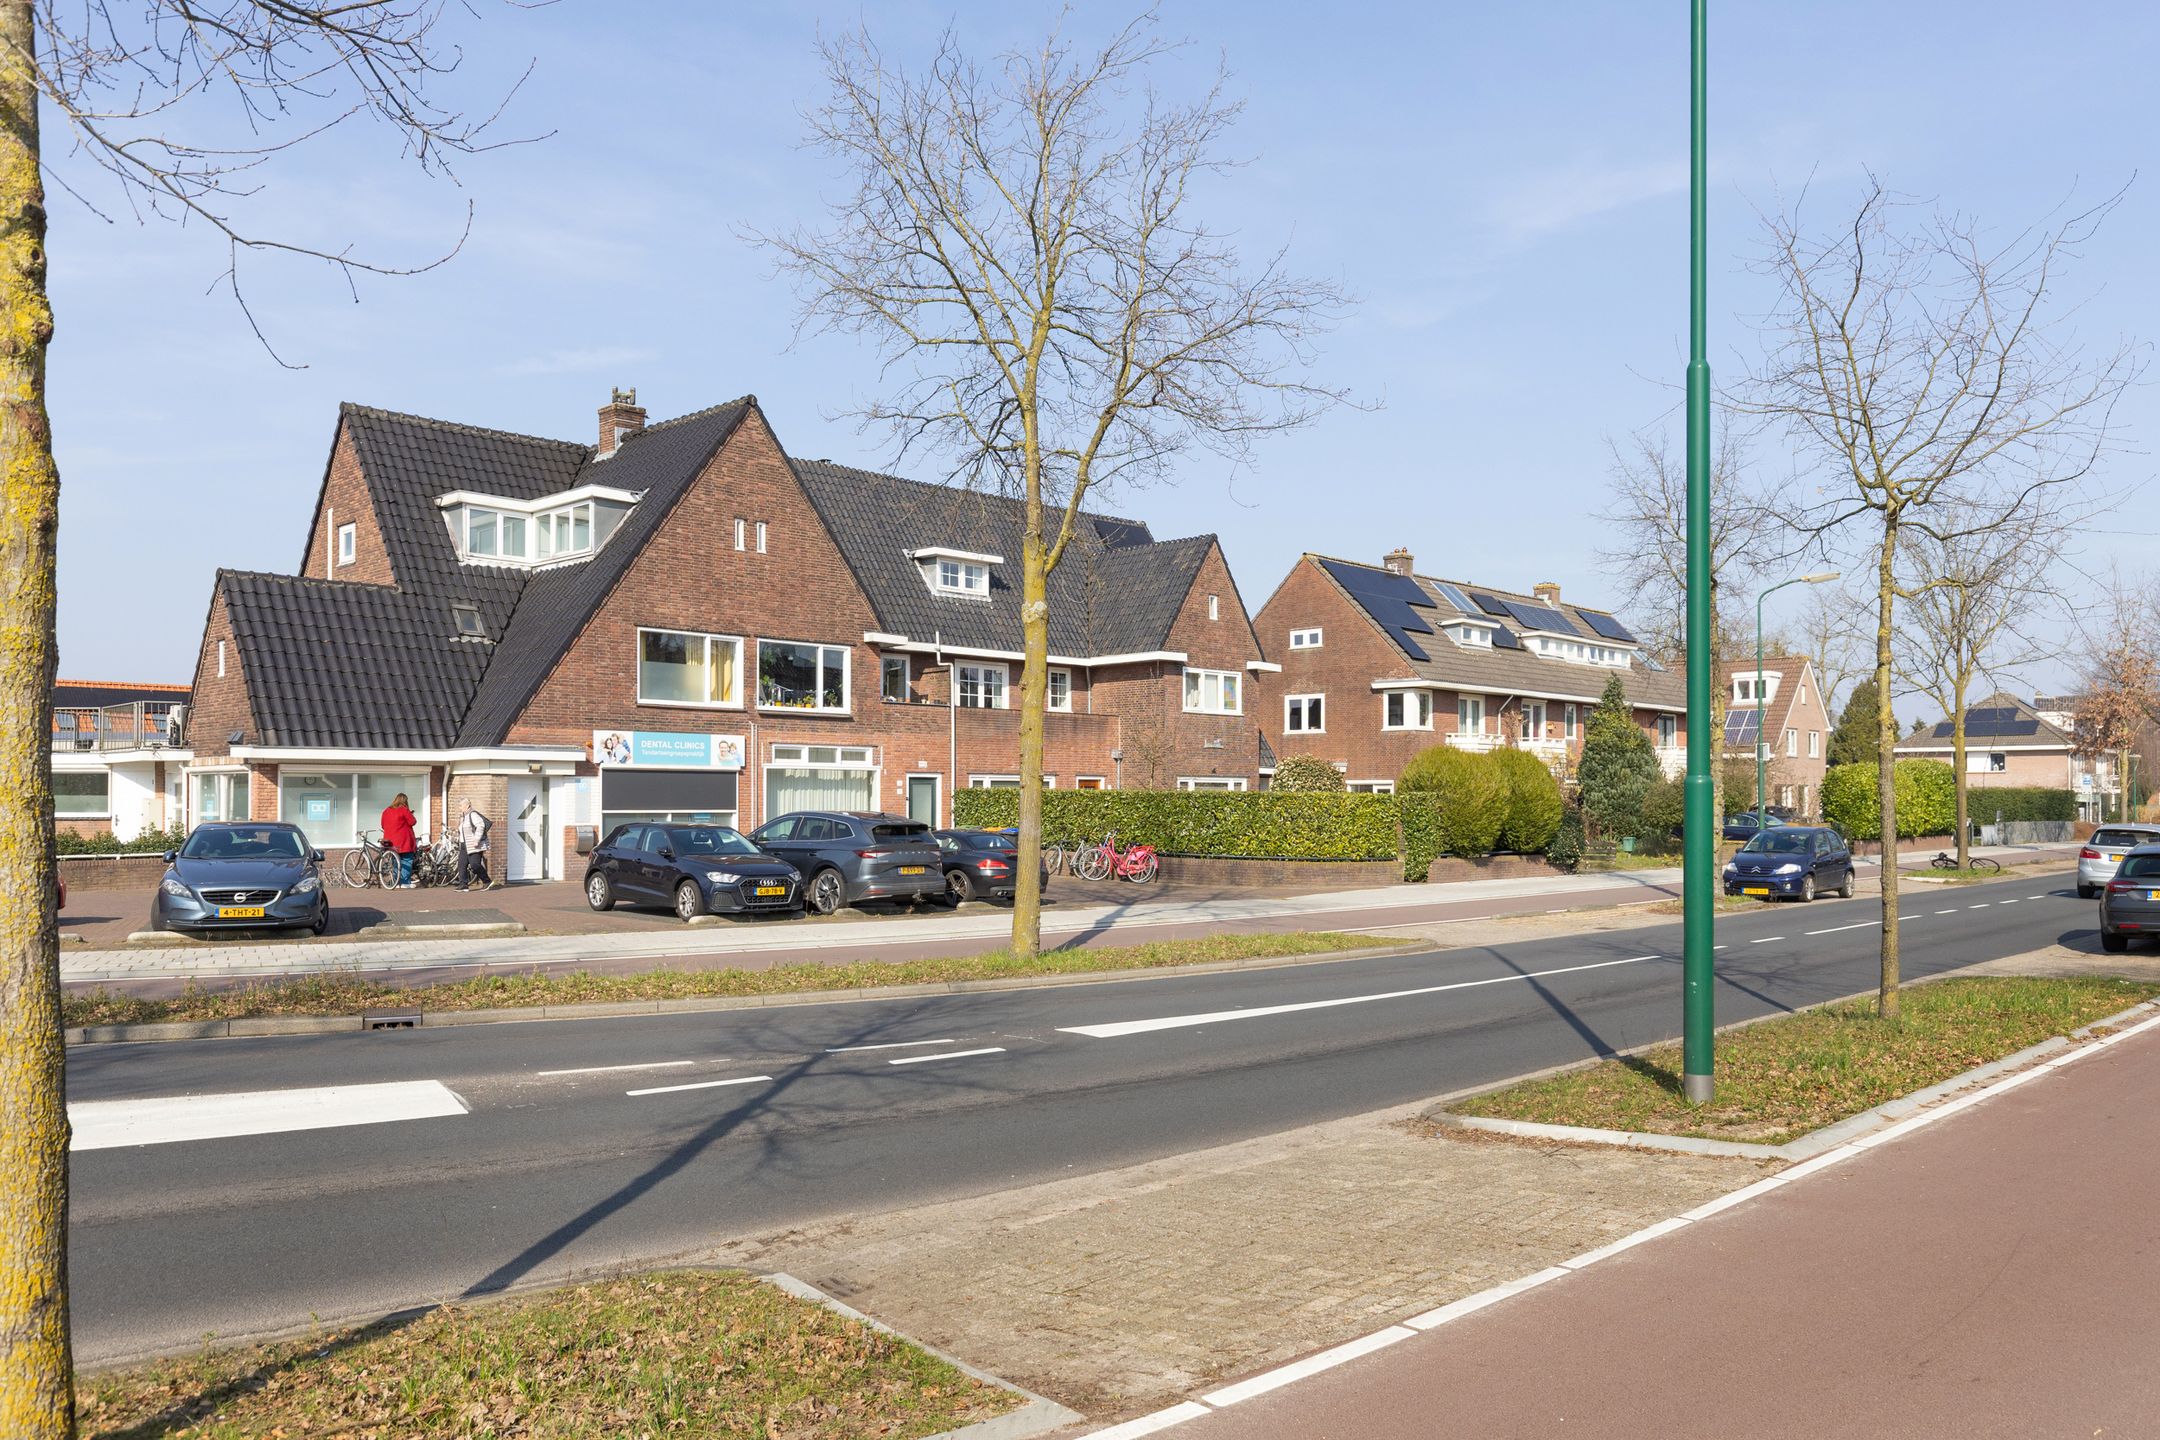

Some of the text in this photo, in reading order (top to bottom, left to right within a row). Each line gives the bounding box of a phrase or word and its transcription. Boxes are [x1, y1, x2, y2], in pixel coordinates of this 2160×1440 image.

[641, 740, 705, 751] DENTAL CLINICS
[223, 908, 260, 916] 4-THT-21
